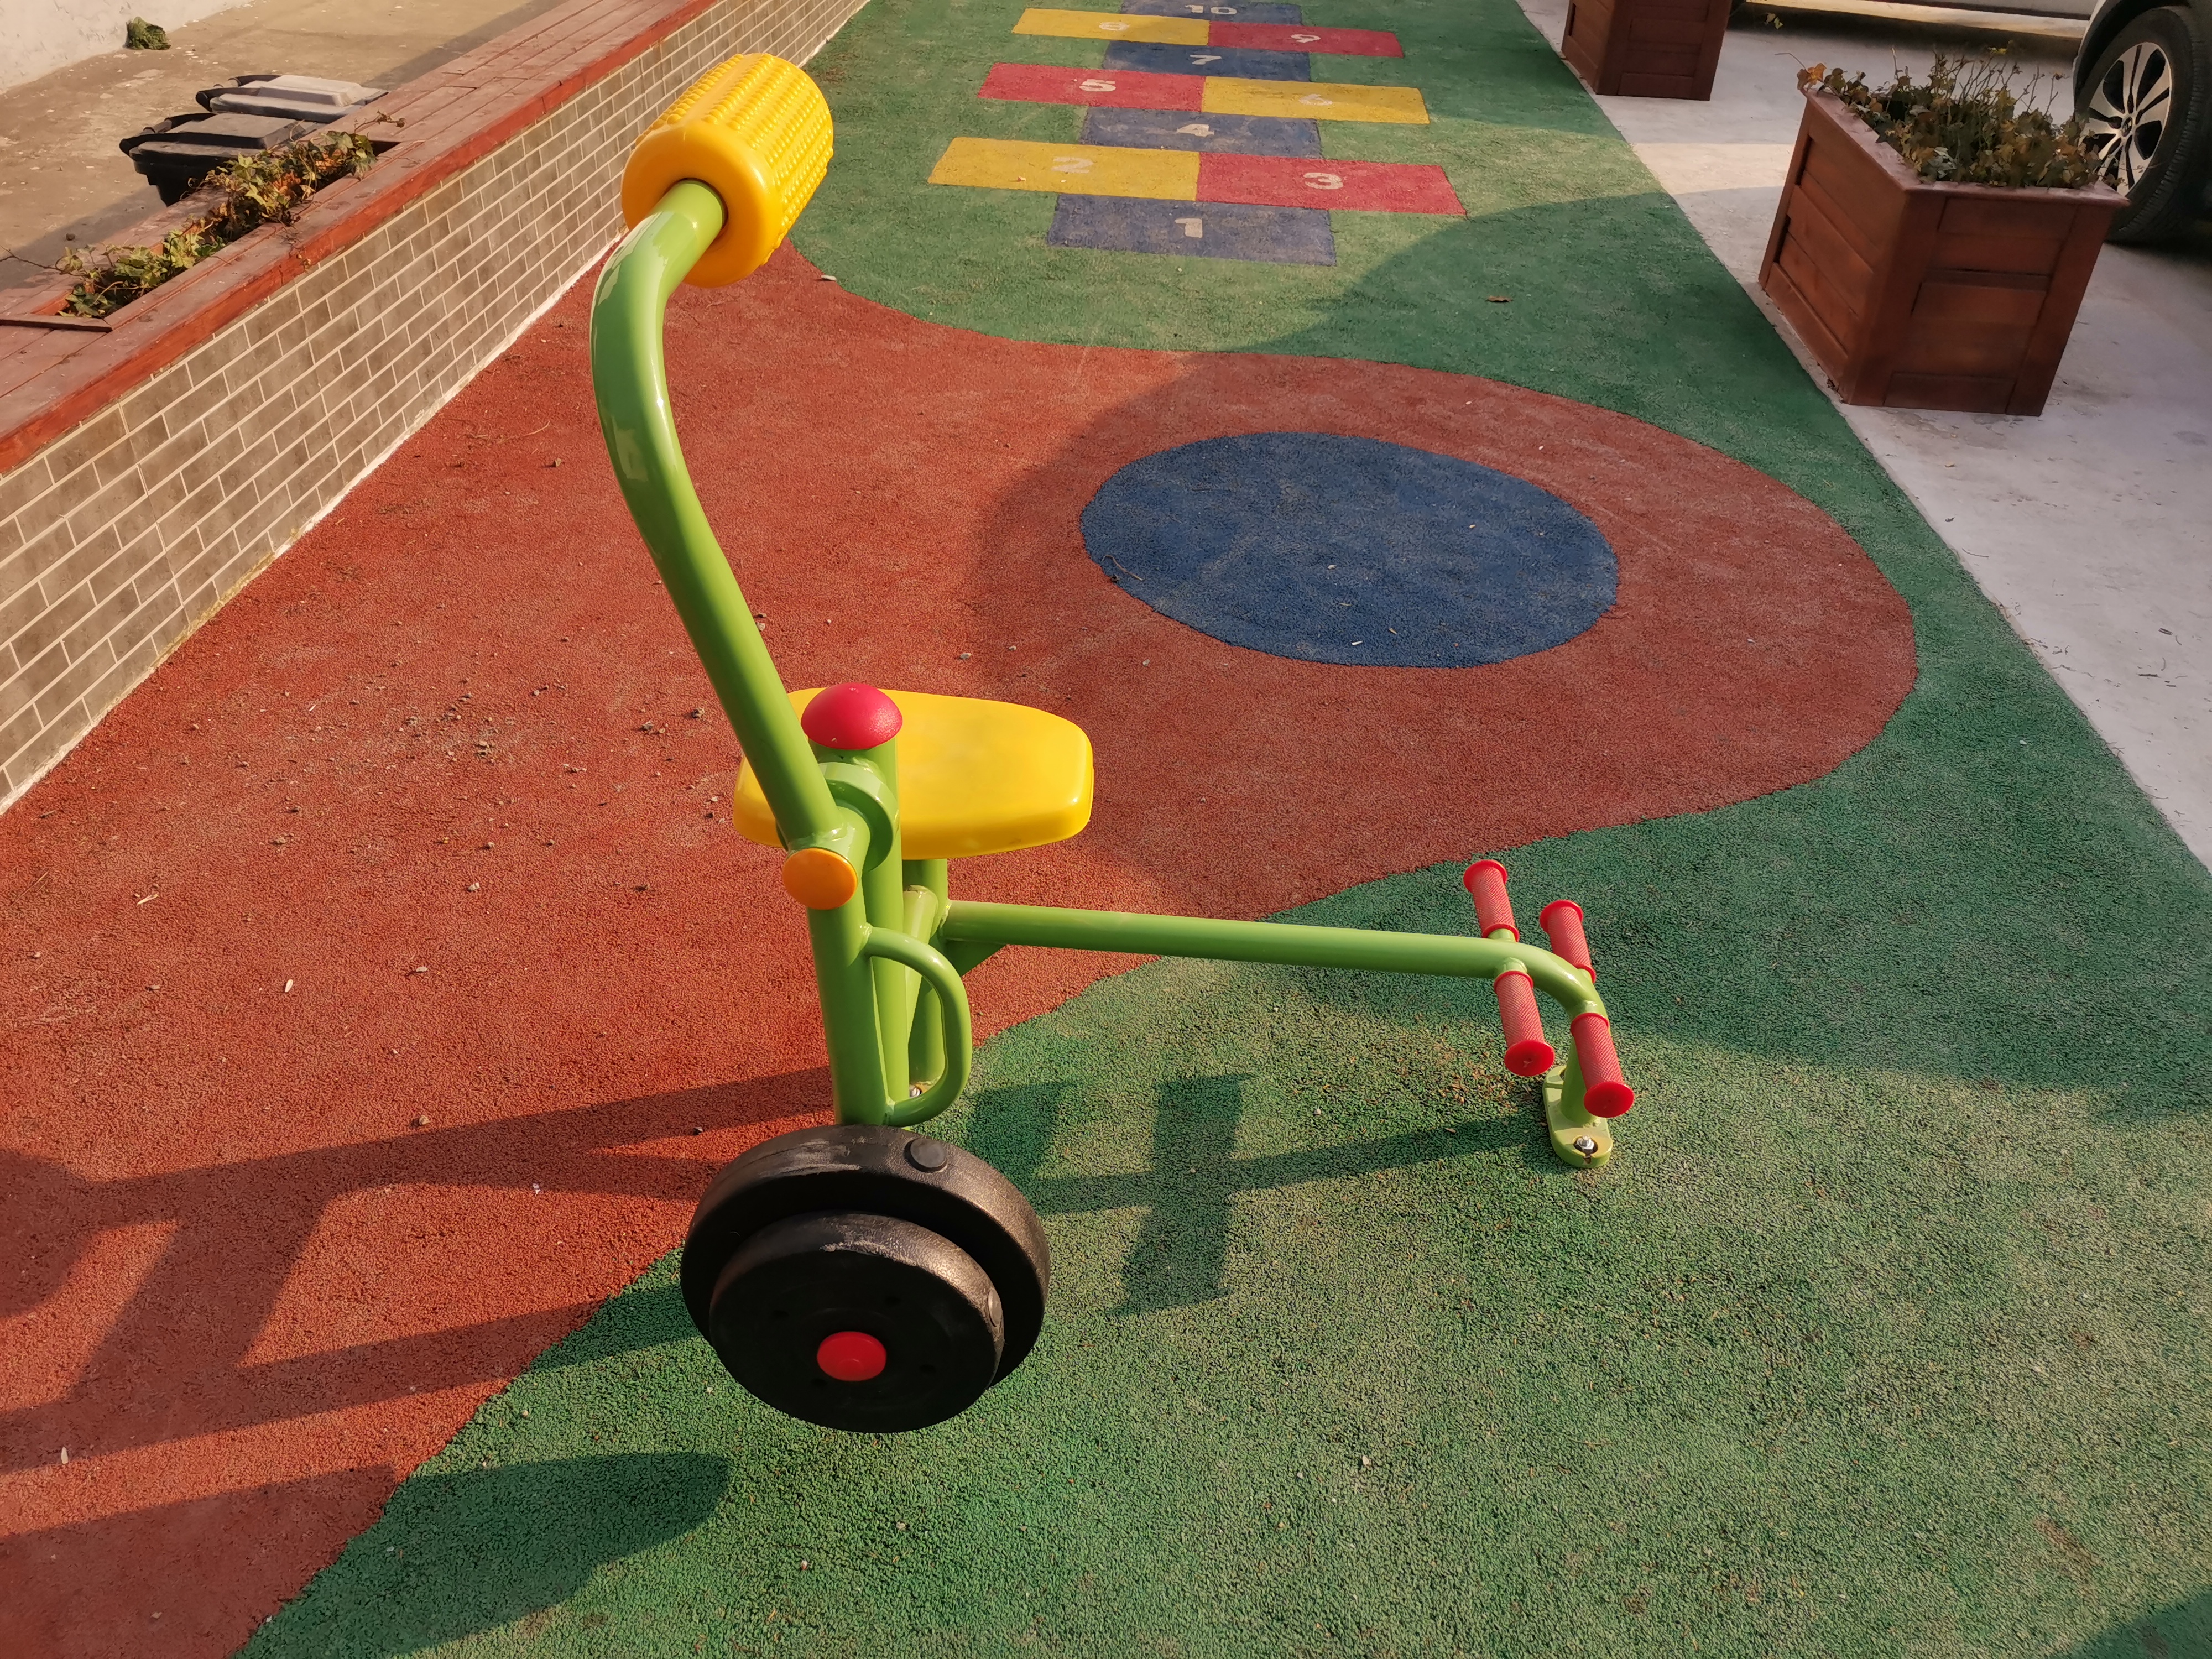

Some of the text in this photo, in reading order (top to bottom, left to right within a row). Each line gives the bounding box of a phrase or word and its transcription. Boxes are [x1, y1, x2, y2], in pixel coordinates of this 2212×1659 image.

[1184, 4, 1237, 15] 10
[1291, 34, 1321, 43] 9
[1190, 54, 1222, 65] 7
[1079, 79, 1116, 92] 5
[1176, 123, 1215, 137] 4
[1052, 156, 1094, 174] 2
[1303, 172, 1343, 190] 3
[1174, 218, 1203, 238] 1
